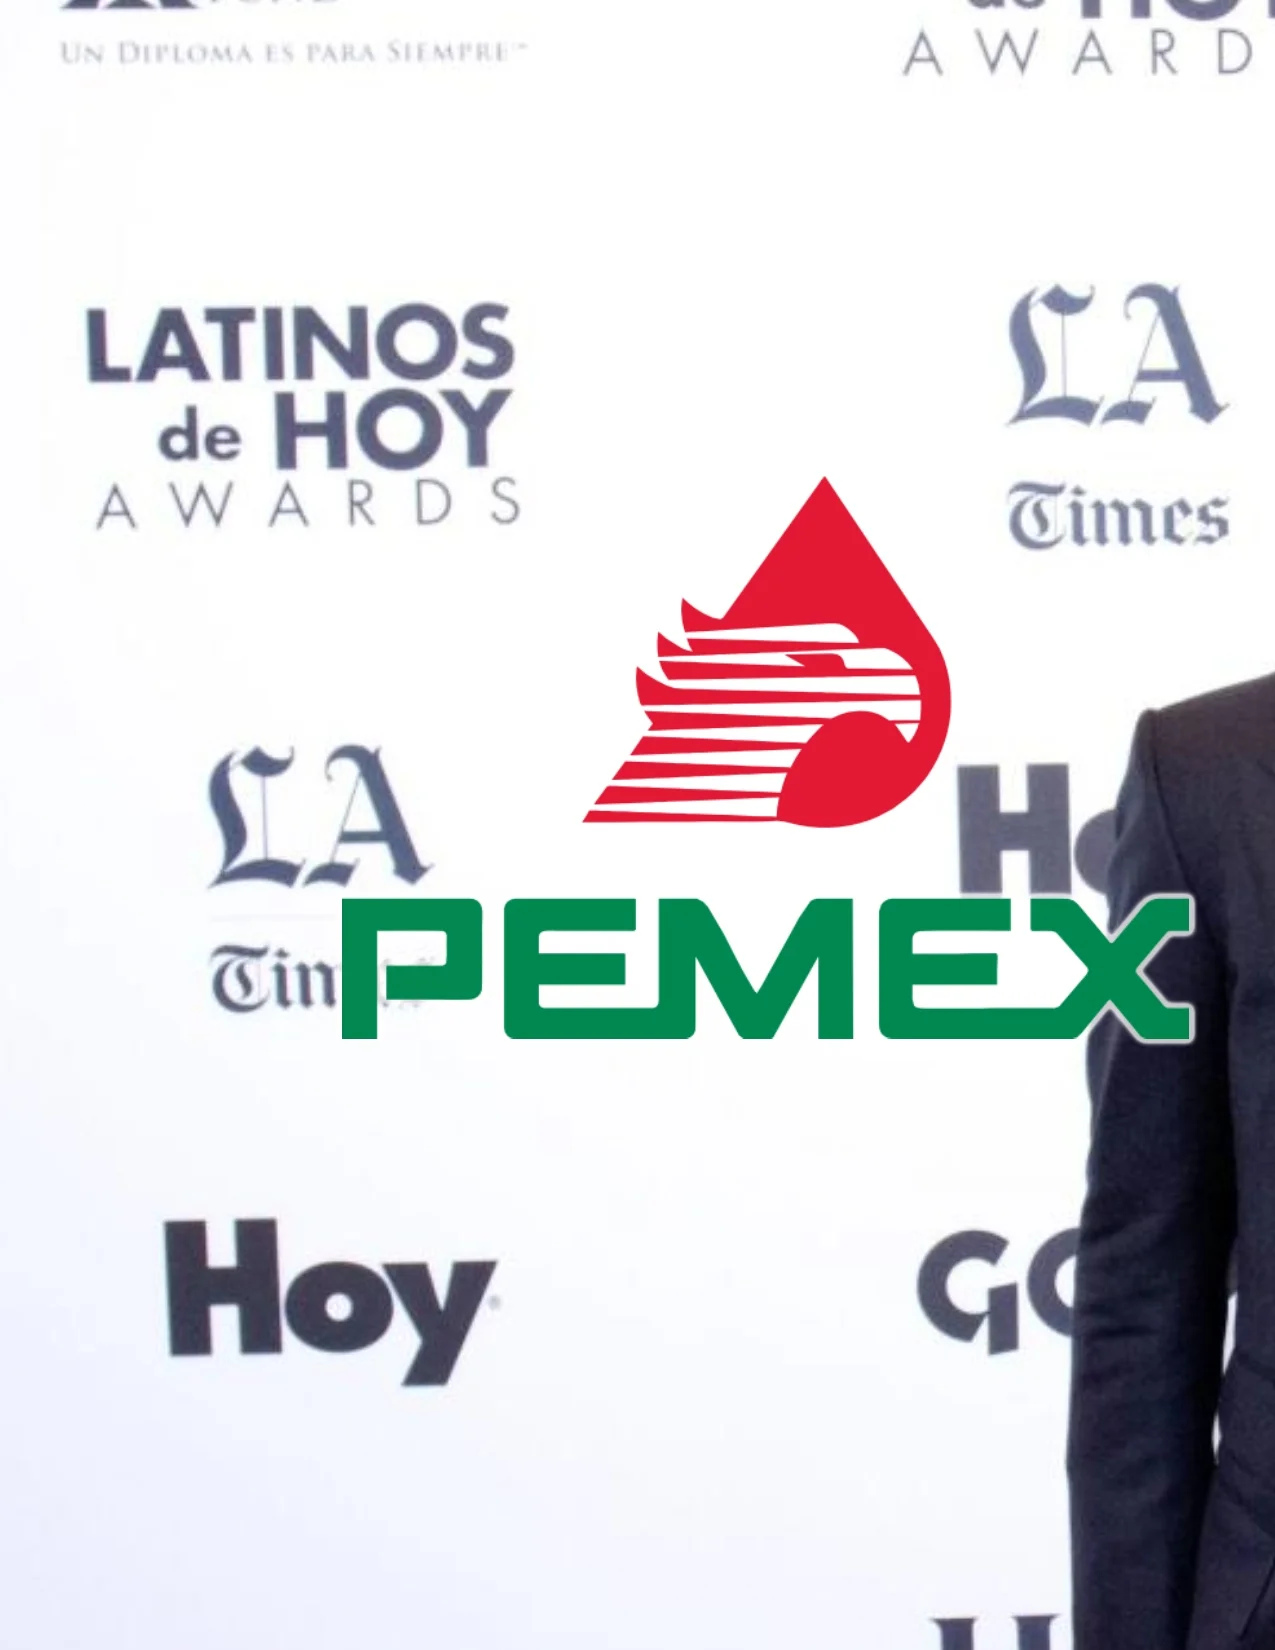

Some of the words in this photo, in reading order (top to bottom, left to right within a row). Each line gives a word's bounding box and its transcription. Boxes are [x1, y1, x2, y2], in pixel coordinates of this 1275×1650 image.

[86, 302, 516, 383] LATINOS
[1006, 282, 1231, 427] LA
[157, 405, 242, 461] de
[273, 387, 514, 471] HOY
[95, 476, 521, 530] AWARDS
[1008, 481, 1231, 551] Times
[207, 743, 435, 889] LA
